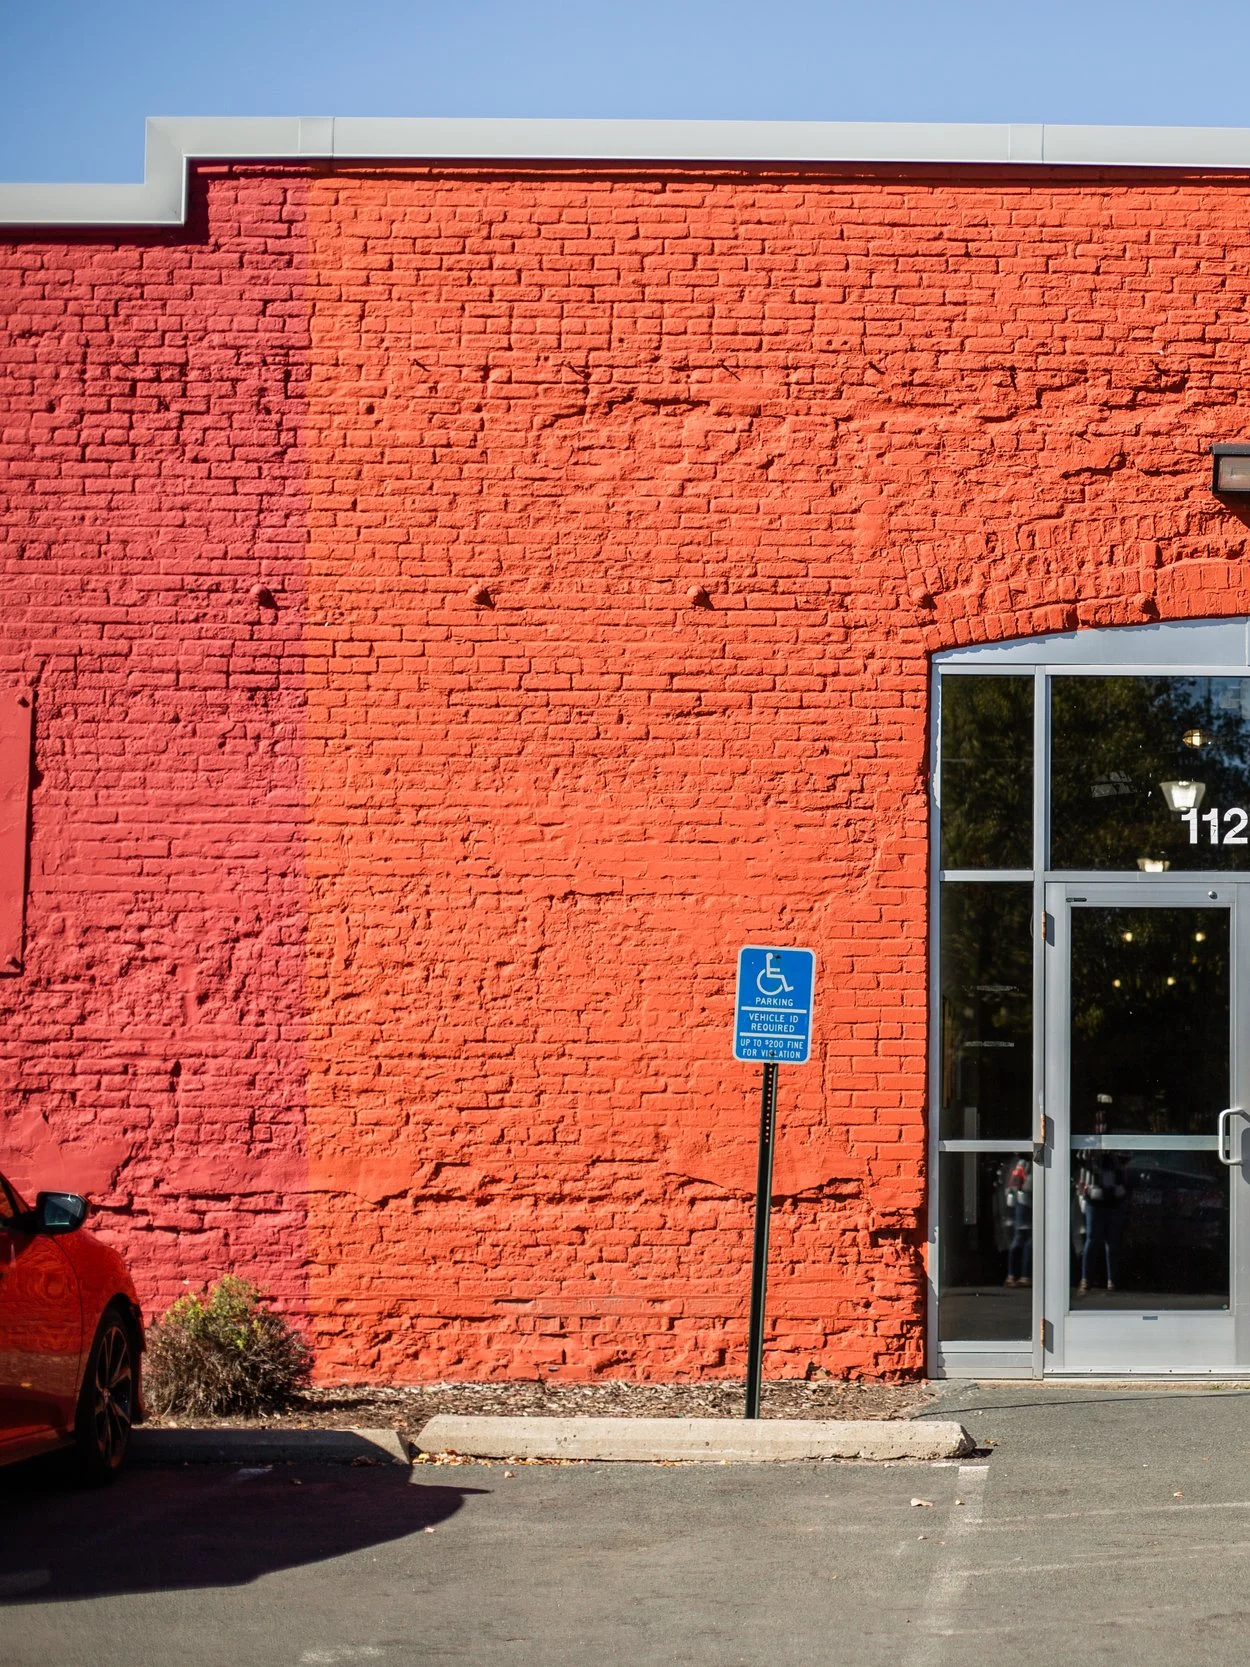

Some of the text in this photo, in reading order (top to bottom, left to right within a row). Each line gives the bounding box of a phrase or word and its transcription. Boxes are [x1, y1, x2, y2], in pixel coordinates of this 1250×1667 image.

[755, 997, 794, 1007] PARKING
[749, 1013, 799, 1023] VEHICLE ID
[751, 1023, 795, 1032] REQUIRED
[740, 1039, 751, 1047] UP
[764, 1040, 784, 1049] $200
[787, 1041, 804, 1049] FINE
[742, 1048, 757, 1057] FOR
